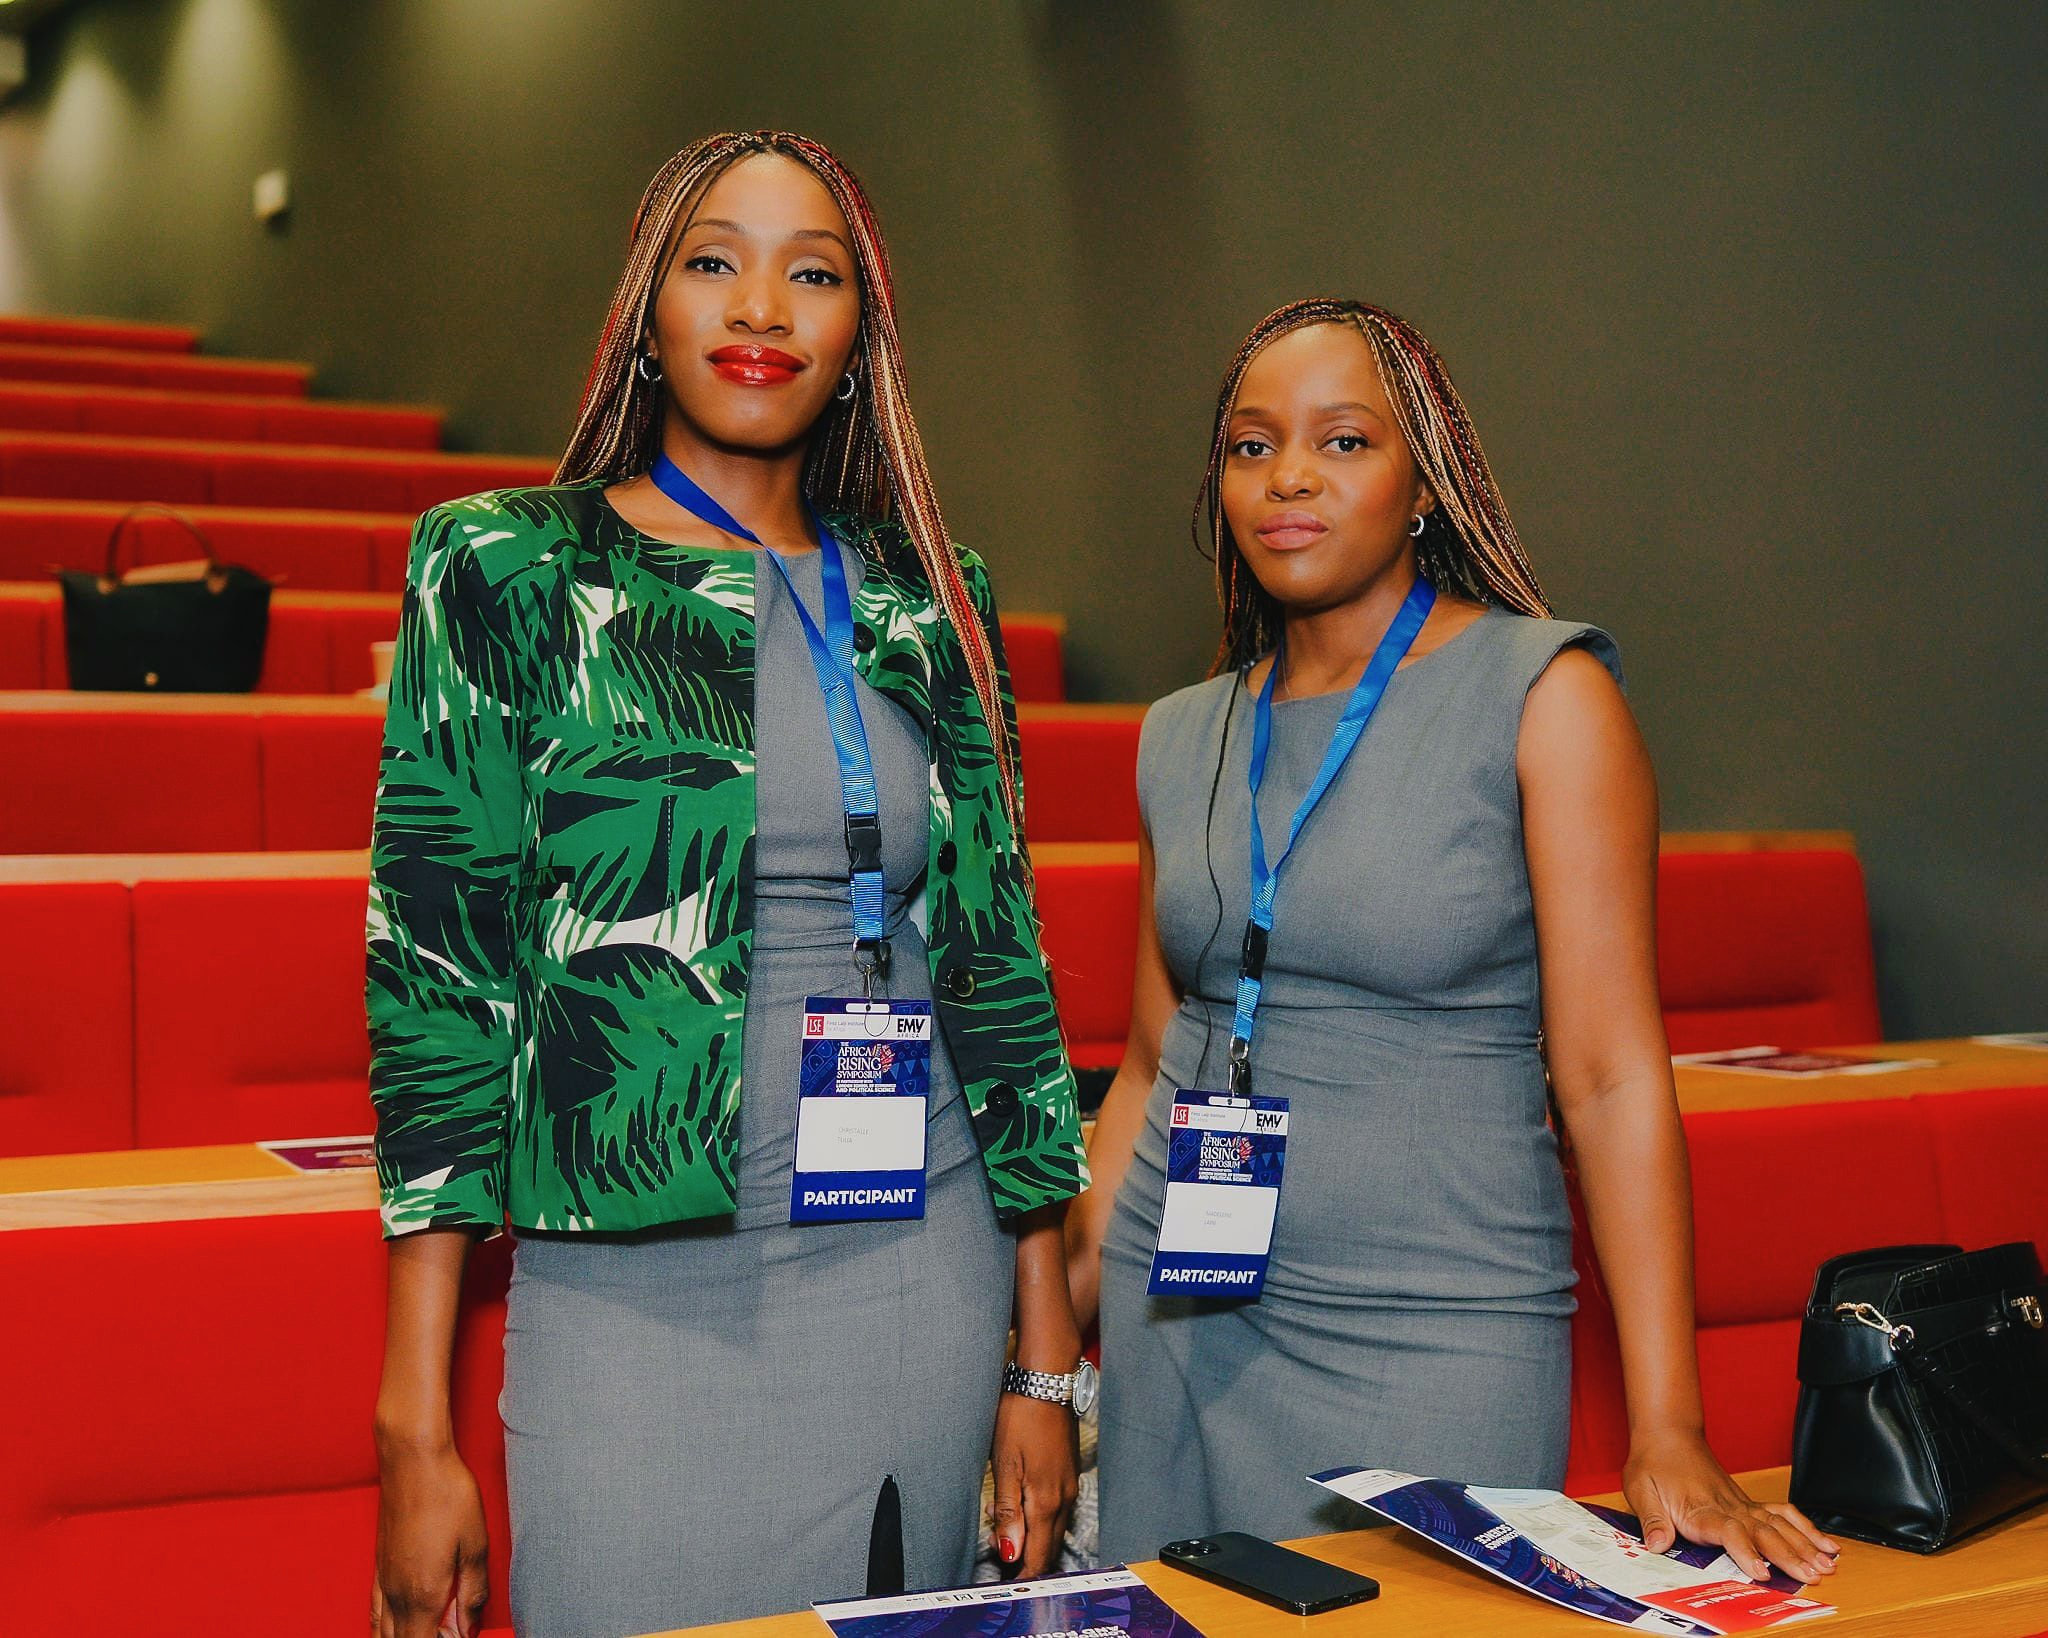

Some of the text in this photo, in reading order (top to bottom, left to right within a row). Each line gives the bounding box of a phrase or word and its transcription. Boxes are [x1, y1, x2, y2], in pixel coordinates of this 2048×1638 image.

[809, 1019, 823, 1033] LSE
[897, 1018, 926, 1033] EMY
[838, 1046, 872, 1056] AFRICA
[837, 1057, 881, 1070] RISING
[836, 1071, 881, 1079] SYMPOSIUM
[1175, 1107, 1188, 1123] LSE
[1256, 1113, 1283, 1128] EMY
[1201, 1136, 1232, 1147] AFRICA
[1200, 1147, 1240, 1161] RISING
[1199, 1160, 1241, 1169] SYMPOSIUM
[803, 1189, 917, 1206] PARTICIPANT
[1160, 1268, 1258, 1284] PARTICIPANT
